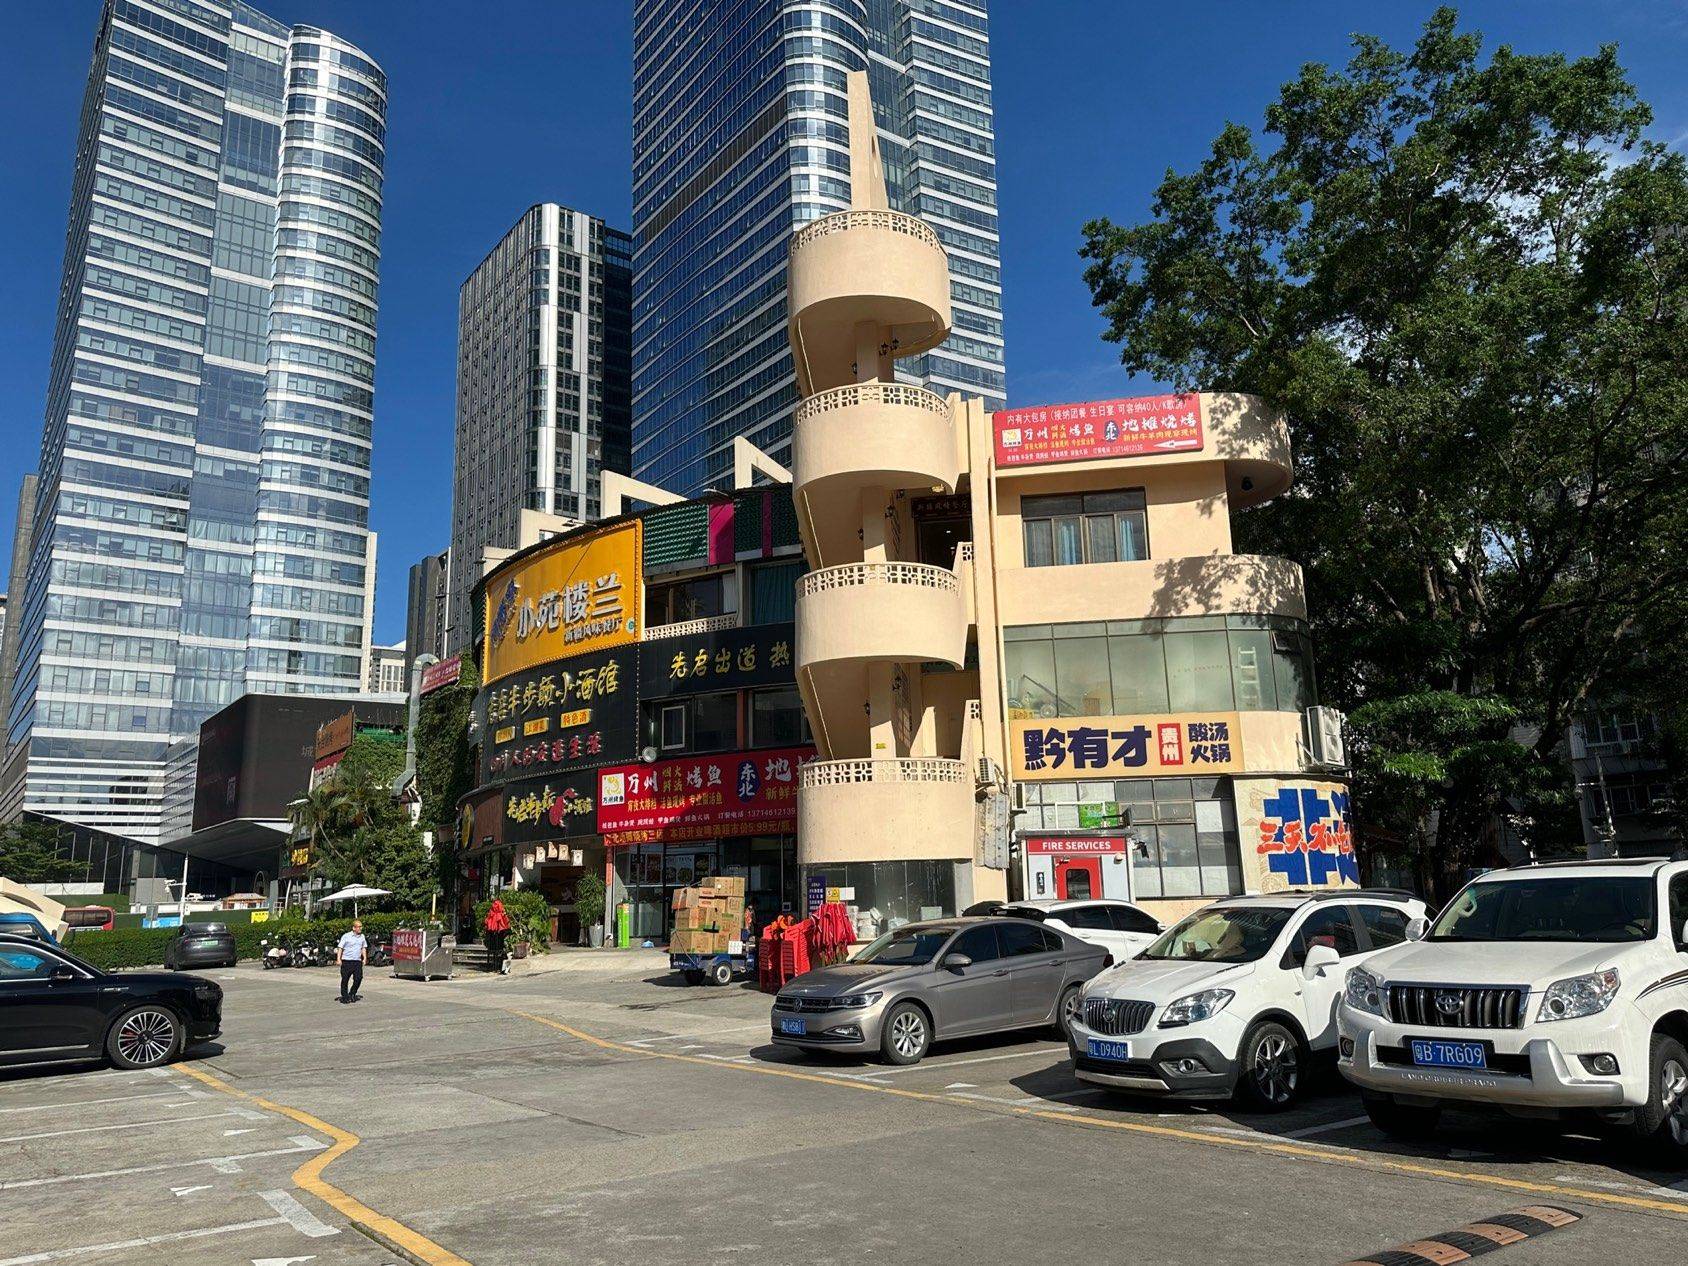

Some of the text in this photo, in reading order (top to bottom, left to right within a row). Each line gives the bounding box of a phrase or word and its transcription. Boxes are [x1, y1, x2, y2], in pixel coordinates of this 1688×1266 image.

[517, 572, 622, 641] 小苑楼兰
[1161, 726, 1180, 763] 贵州
[1187, 722, 1229, 741] 酸汤
[1023, 725, 1152, 771] 黔有才
[1190, 743, 1231, 763] 火锅
[627, 764, 722, 794] 万州 烤鱼
[739, 763, 757, 798] 东北
[1042, 841, 1111, 850] FIRE SERVICES
